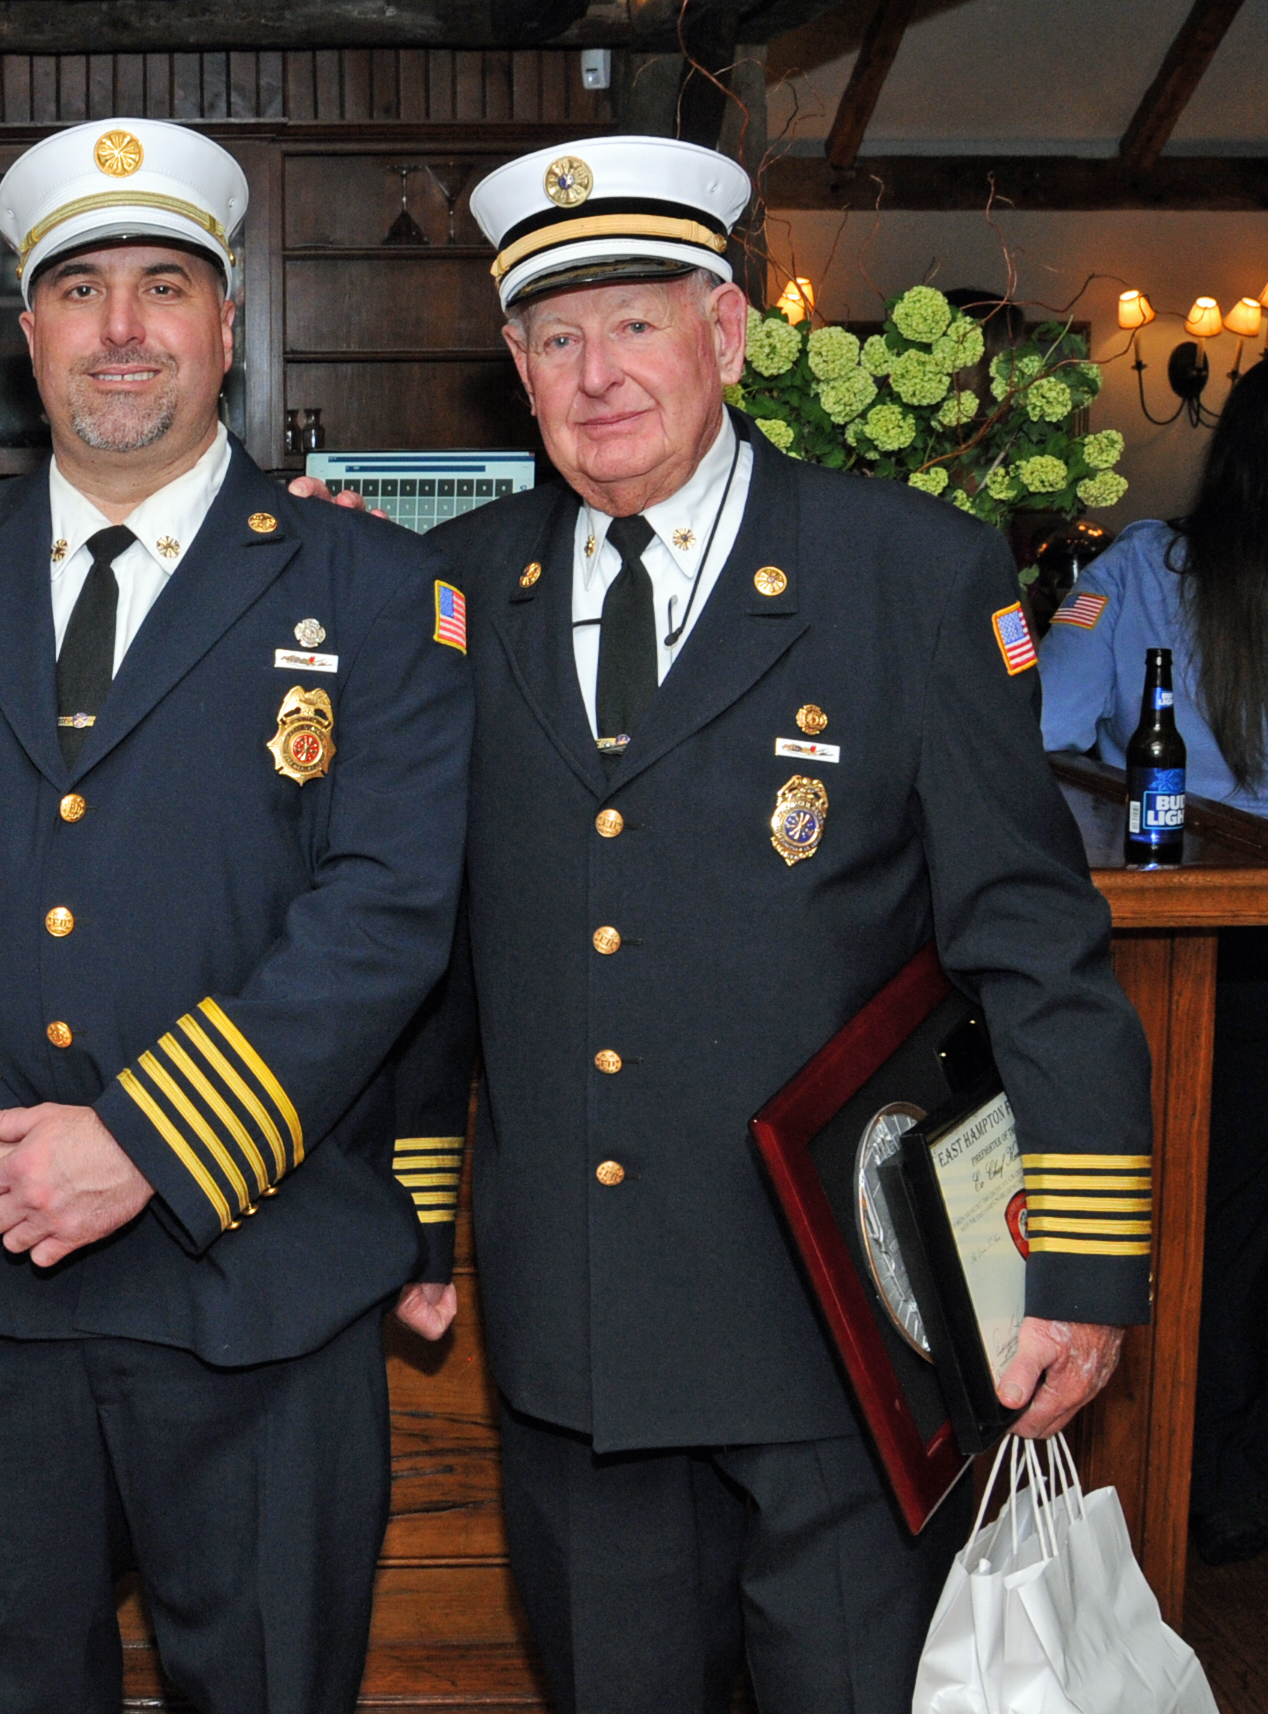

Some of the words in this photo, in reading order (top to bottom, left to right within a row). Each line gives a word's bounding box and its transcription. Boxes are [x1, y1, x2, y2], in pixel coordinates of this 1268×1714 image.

[1147, 809, 1184, 826] LIGH
[937, 1136, 964, 1168] EAST
[962, 1105, 1006, 1149] HAMPTON
